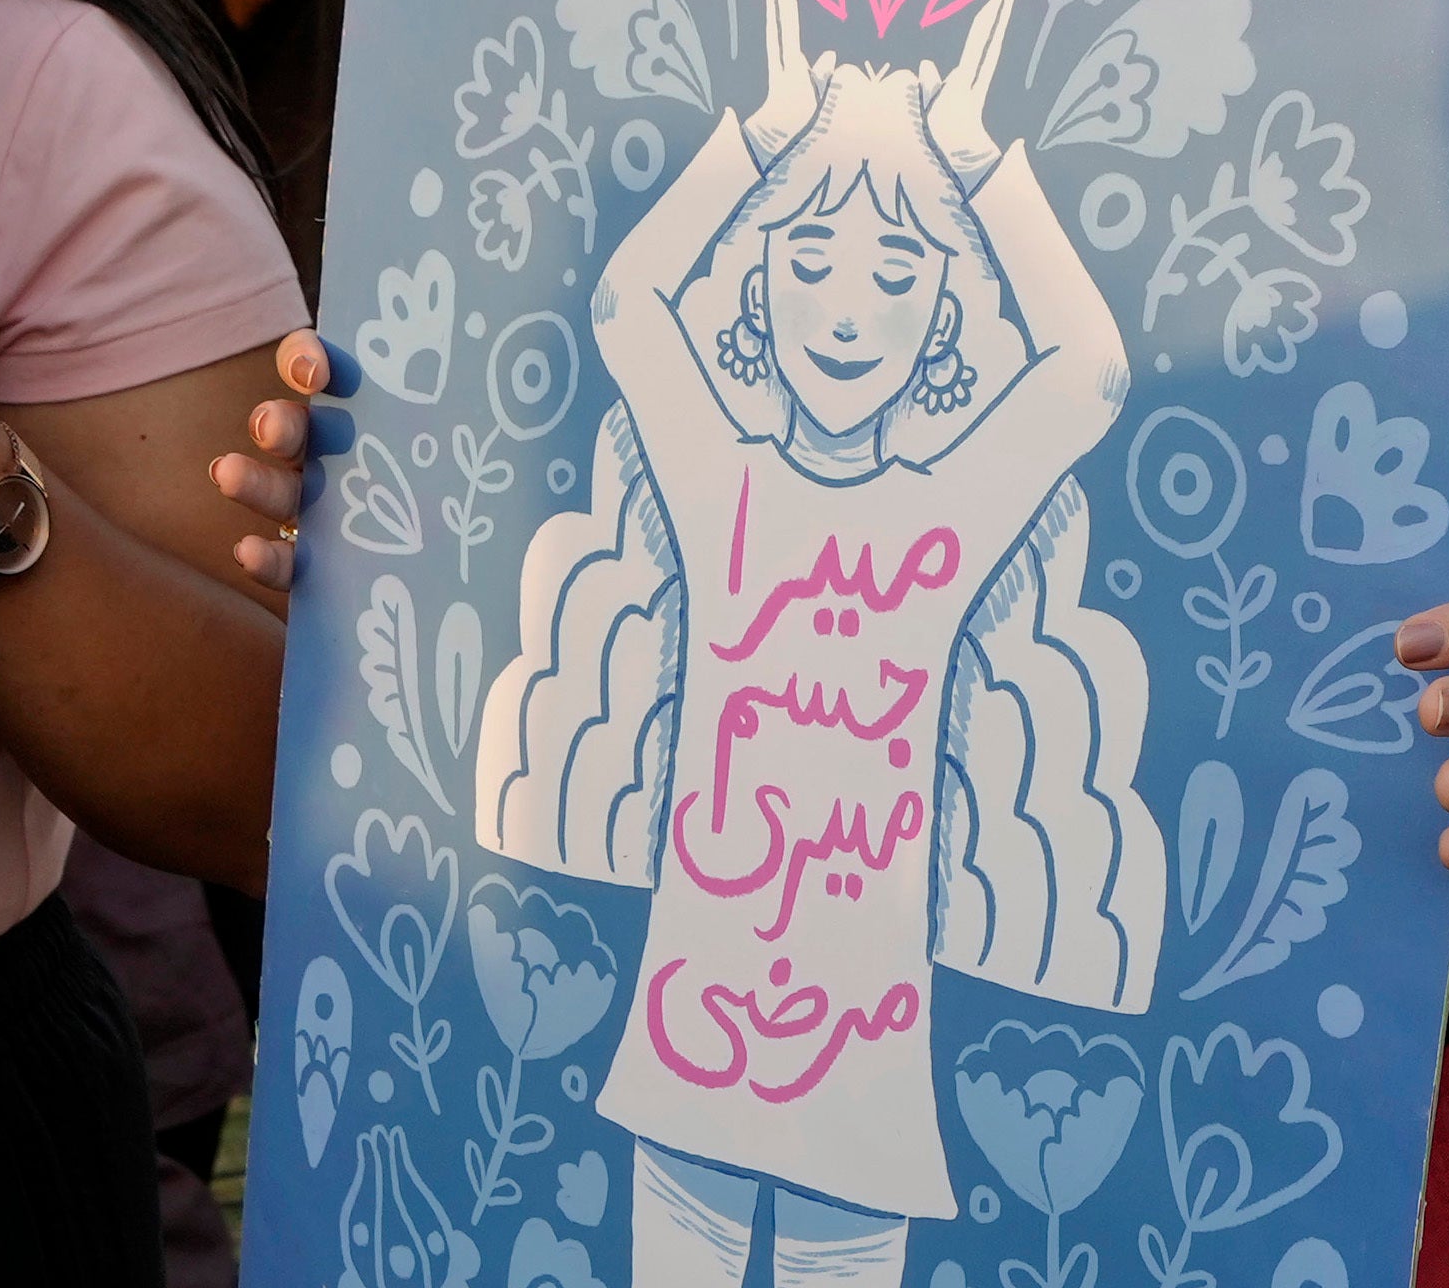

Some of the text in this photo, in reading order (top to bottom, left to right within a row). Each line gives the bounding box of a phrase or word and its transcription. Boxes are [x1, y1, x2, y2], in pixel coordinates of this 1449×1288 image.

[709, 465, 961, 661] میرا
[711, 658, 929, 833] جسم
[673, 784, 924, 942] میری
[647, 957, 920, 1104] مرضی
